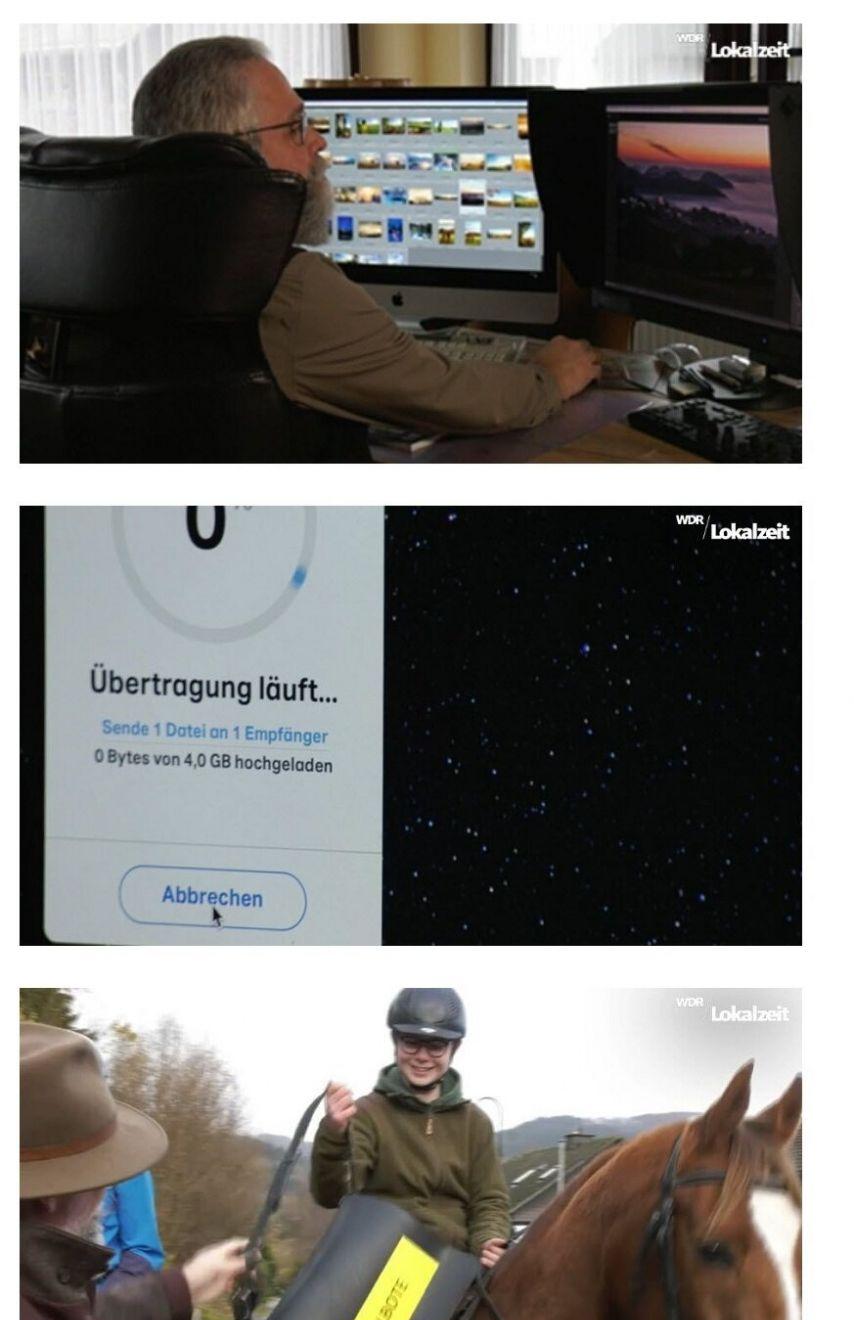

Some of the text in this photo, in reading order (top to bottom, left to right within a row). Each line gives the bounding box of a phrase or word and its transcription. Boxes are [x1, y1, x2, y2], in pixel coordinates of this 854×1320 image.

[91, 663, 338, 705] Übertragung läuft...
[102, 719, 328, 746] Sende 1 Datei an 1 Empfänger
[95, 748, 333, 774] 0 Bytes von 4,0 GB hochgeladen
[162, 885, 263, 907] Abbrechen
